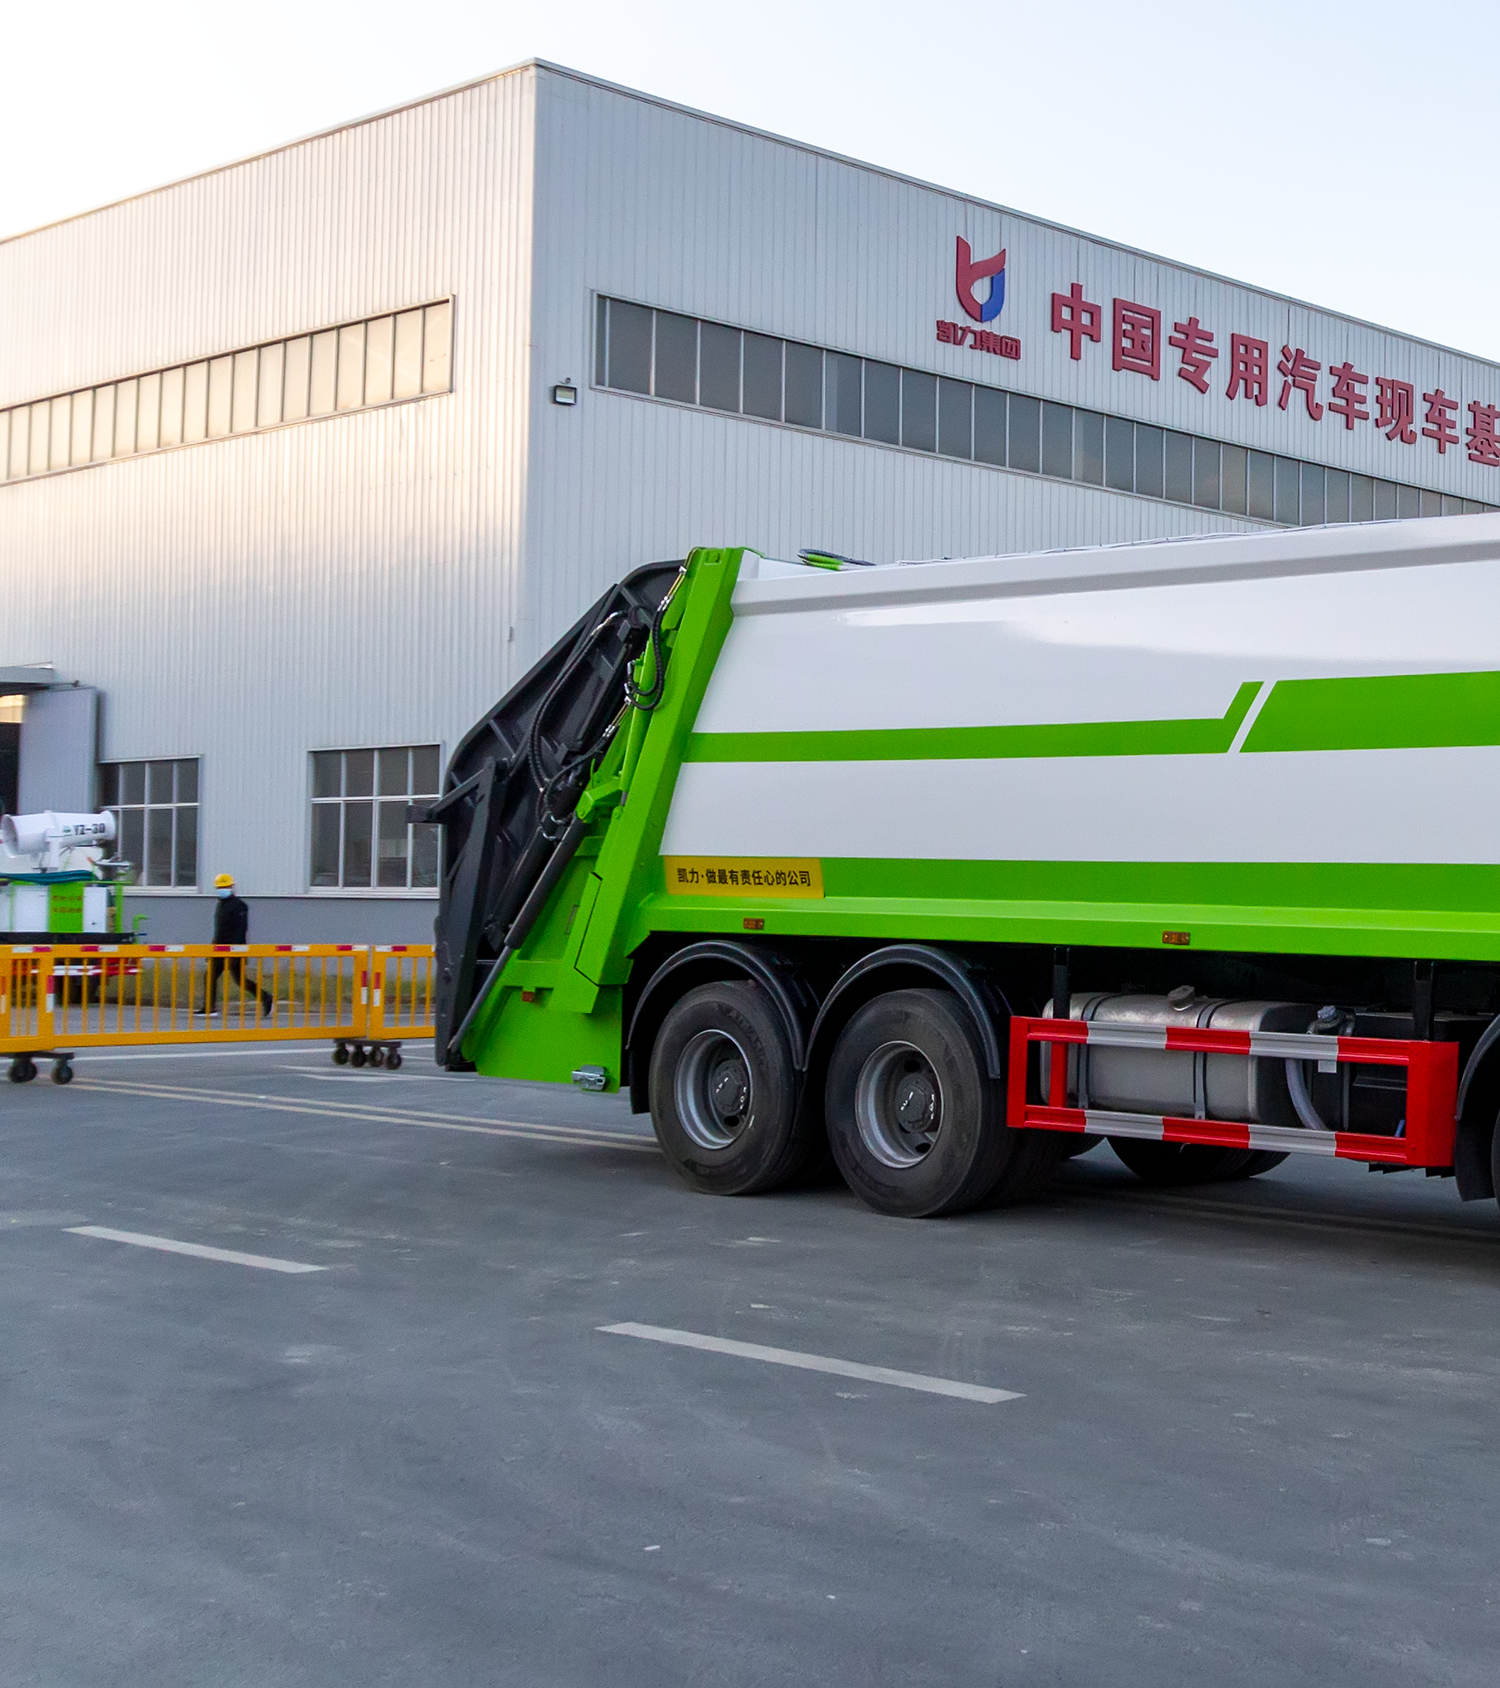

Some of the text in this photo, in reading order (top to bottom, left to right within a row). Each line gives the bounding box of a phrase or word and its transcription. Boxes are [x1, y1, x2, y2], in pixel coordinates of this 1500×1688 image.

[936, 319, 1022, 361] 凯力集团
[676, 867, 811, 887] 凯力·做最有责任心的公司
